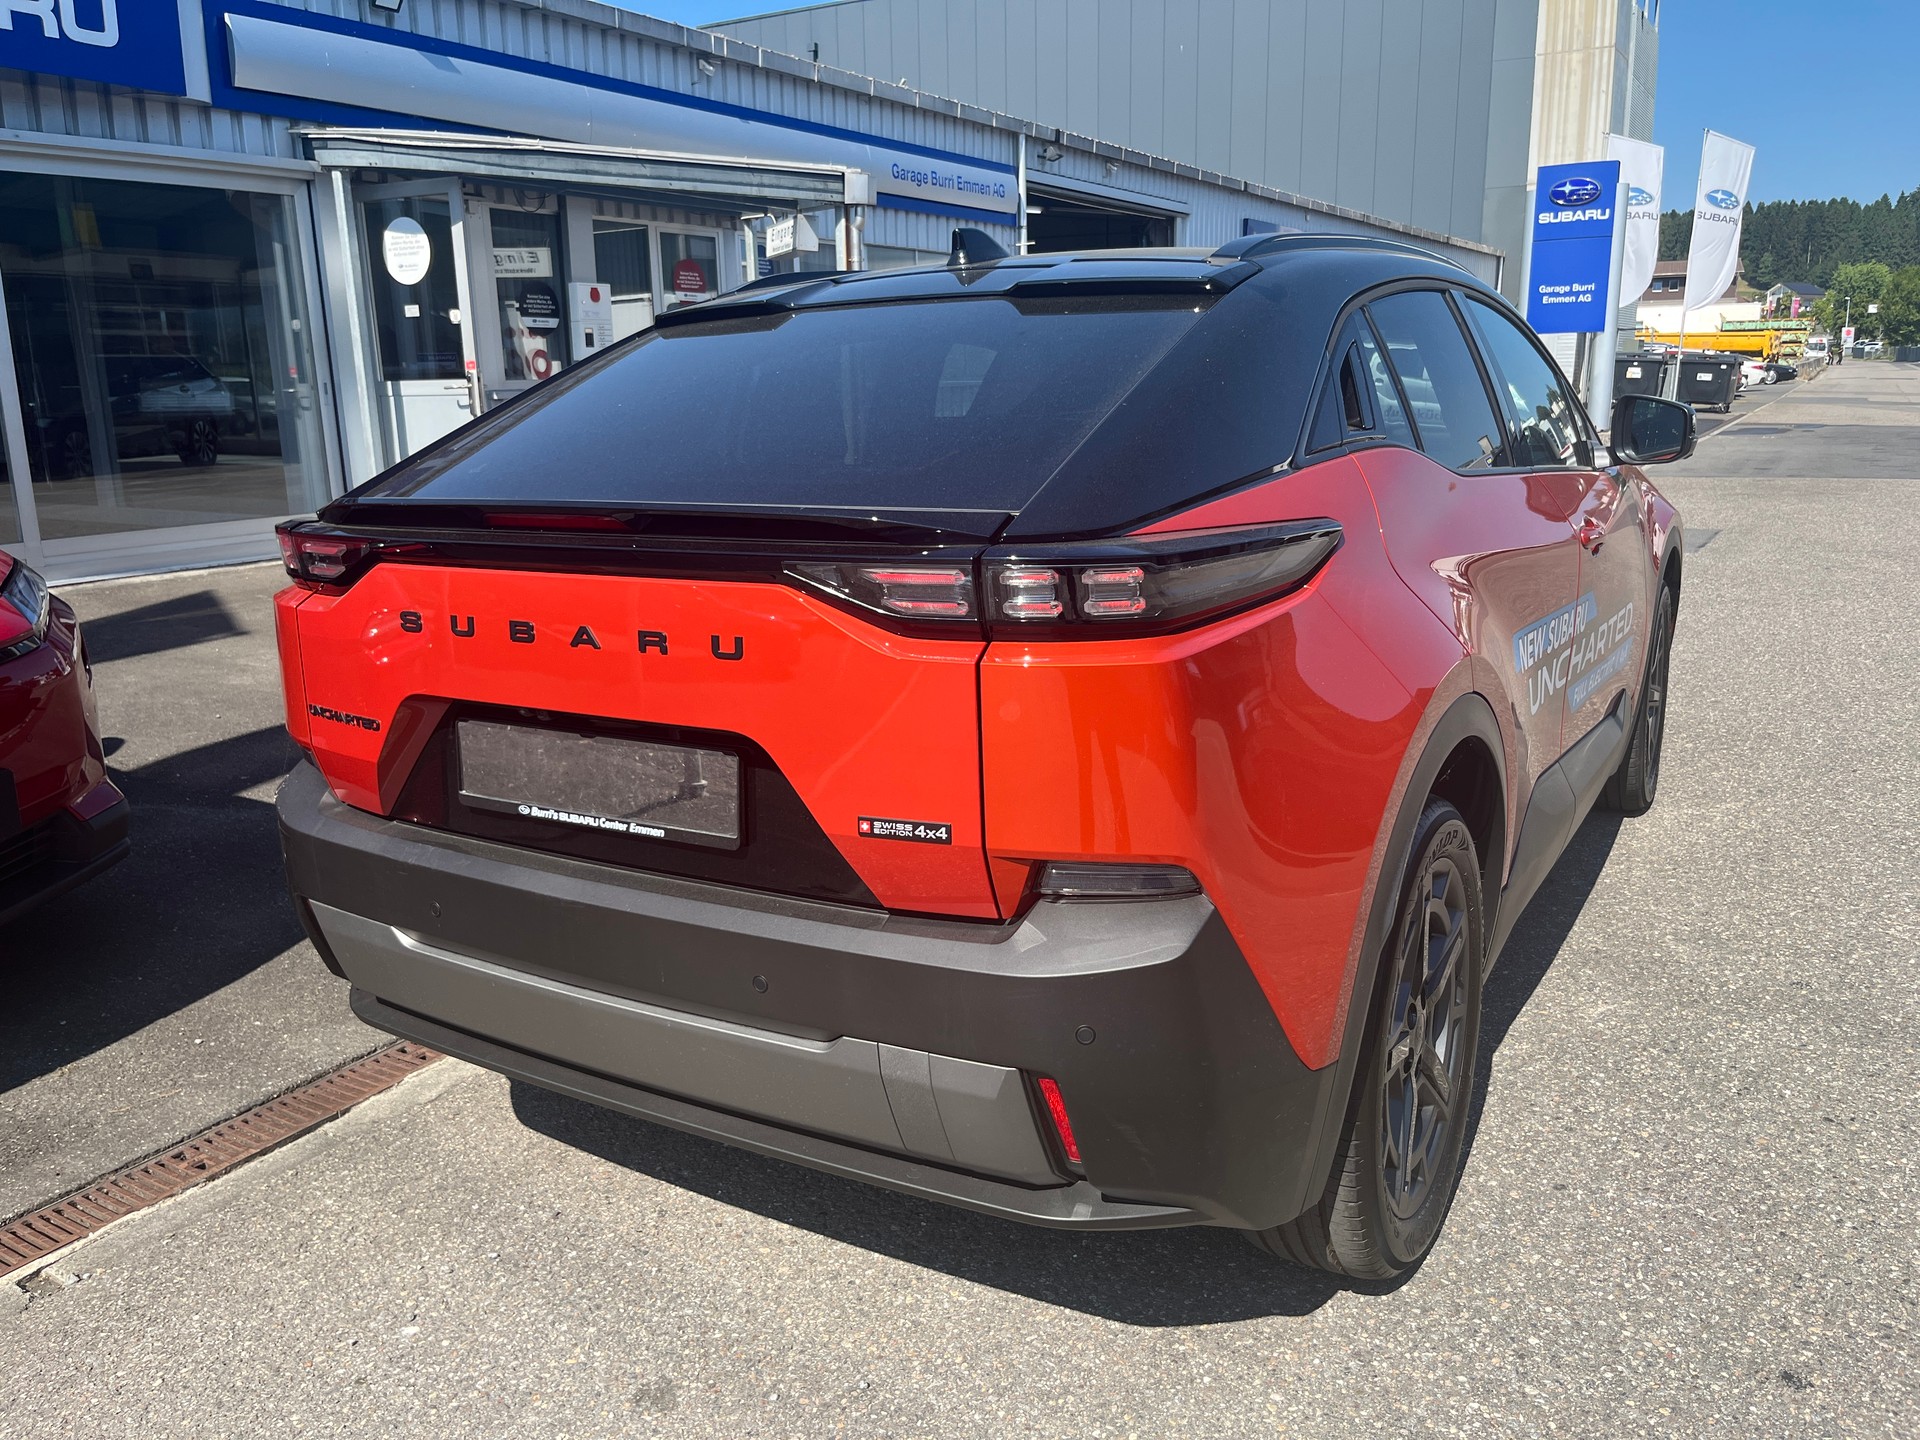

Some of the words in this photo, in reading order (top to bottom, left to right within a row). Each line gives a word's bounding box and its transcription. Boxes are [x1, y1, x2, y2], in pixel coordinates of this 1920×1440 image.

[891, 163, 929, 187] Garage
[930, 170, 955, 189] Burri
[957, 176, 990, 196] Emmen
[992, 183, 1005, 198] AG
[1538, 208, 1610, 224] SUBARU
[1538, 284, 1571, 294] Garage
[1572, 282, 1595, 292] Burri
[1542, 295, 1576, 304] Emmen
[1577, 294, 1592, 302] AG
[400, 610, 744, 661] SUBARU
[1518, 624, 1547, 674] NEW
[1547, 601, 1590, 654] SUBARU
[1529, 602, 1634, 716] UNCHARTED
[309, 703, 381, 732] UNCHARTED
[531, 806, 558, 820] Burri's
[559, 812, 598, 827] SUBARU
[599, 817, 628, 831] Center
[629, 823, 665, 838] Emmen
[873, 821, 913, 831] SWISS
[914, 825, 948, 840] 4x4
[873, 828, 913, 837] EDITION
